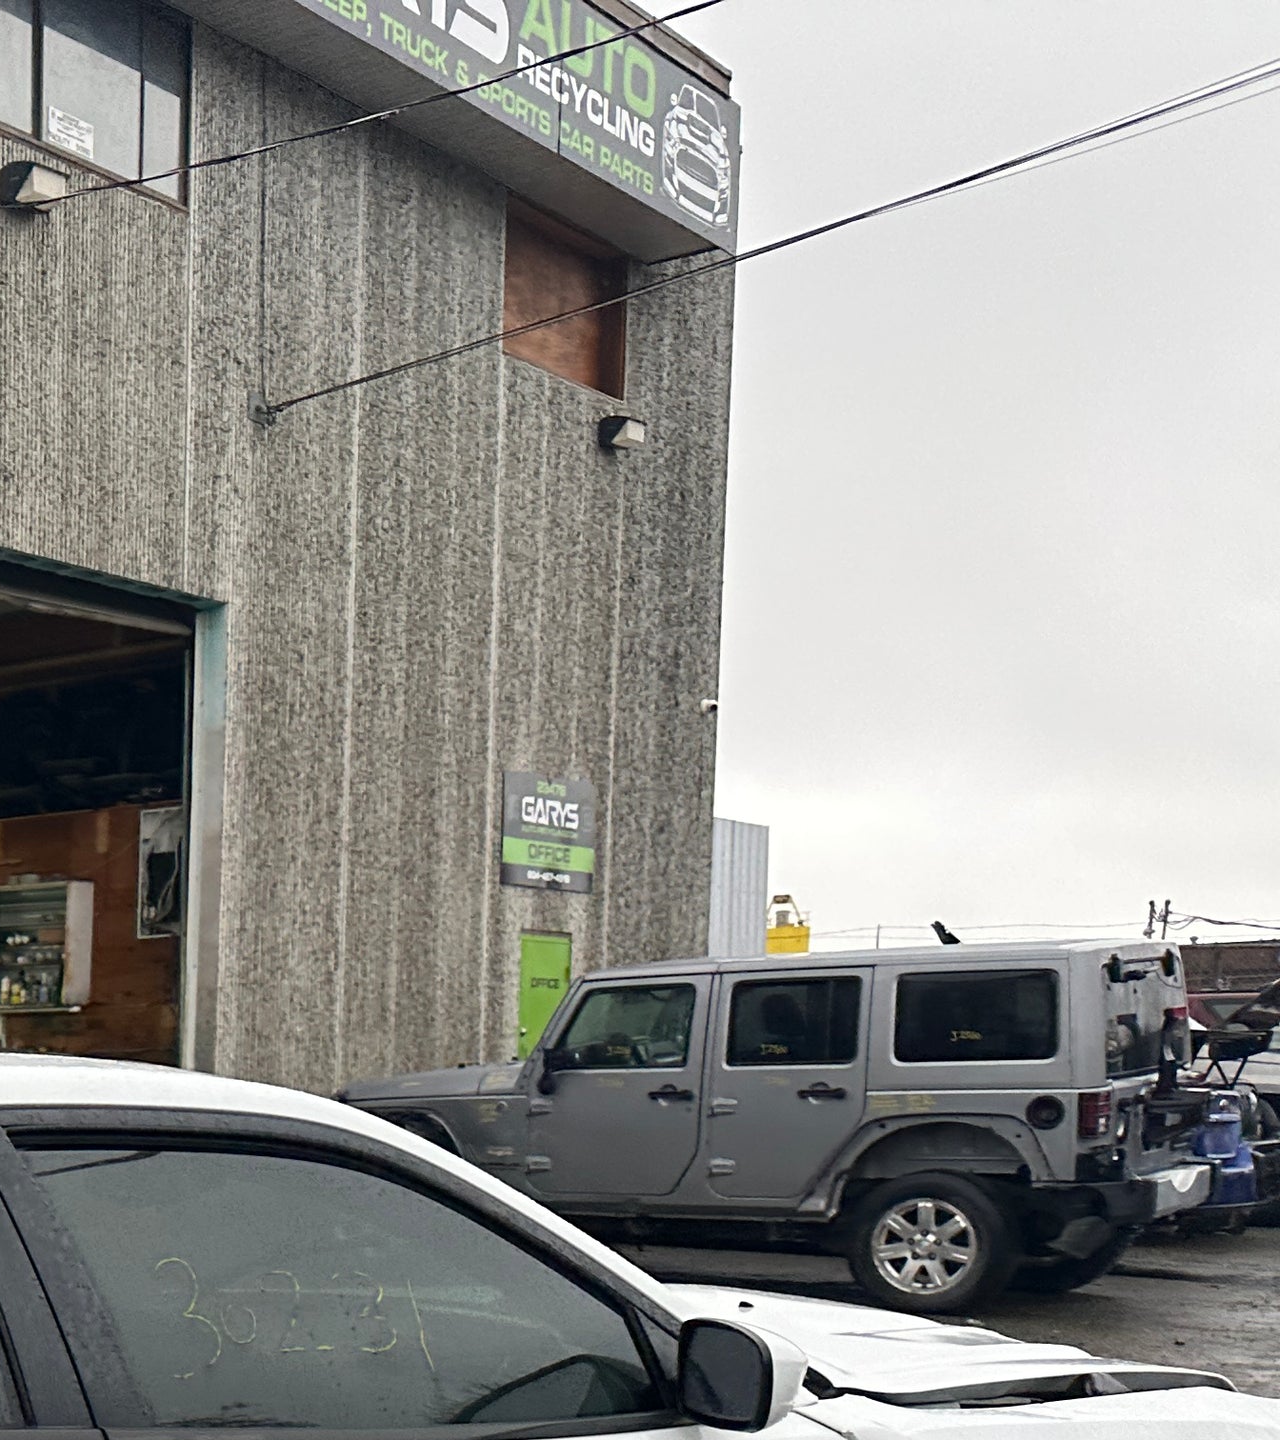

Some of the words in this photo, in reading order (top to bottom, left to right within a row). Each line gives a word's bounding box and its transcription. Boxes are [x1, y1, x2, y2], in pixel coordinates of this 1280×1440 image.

[380, 12, 449, 76] TRUCK
[455, 58, 470, 88] &
[476, 73, 552, 136] SPORTS
[560, 120, 595, 162] CAR
[600, 145, 654, 196] PARTS
[517, 43, 656, 157] RECYCLING
[518, 0, 657, 119] AUTO
[521, 796, 579, 830] GARYS
[527, 843, 571, 864] OFFICE
